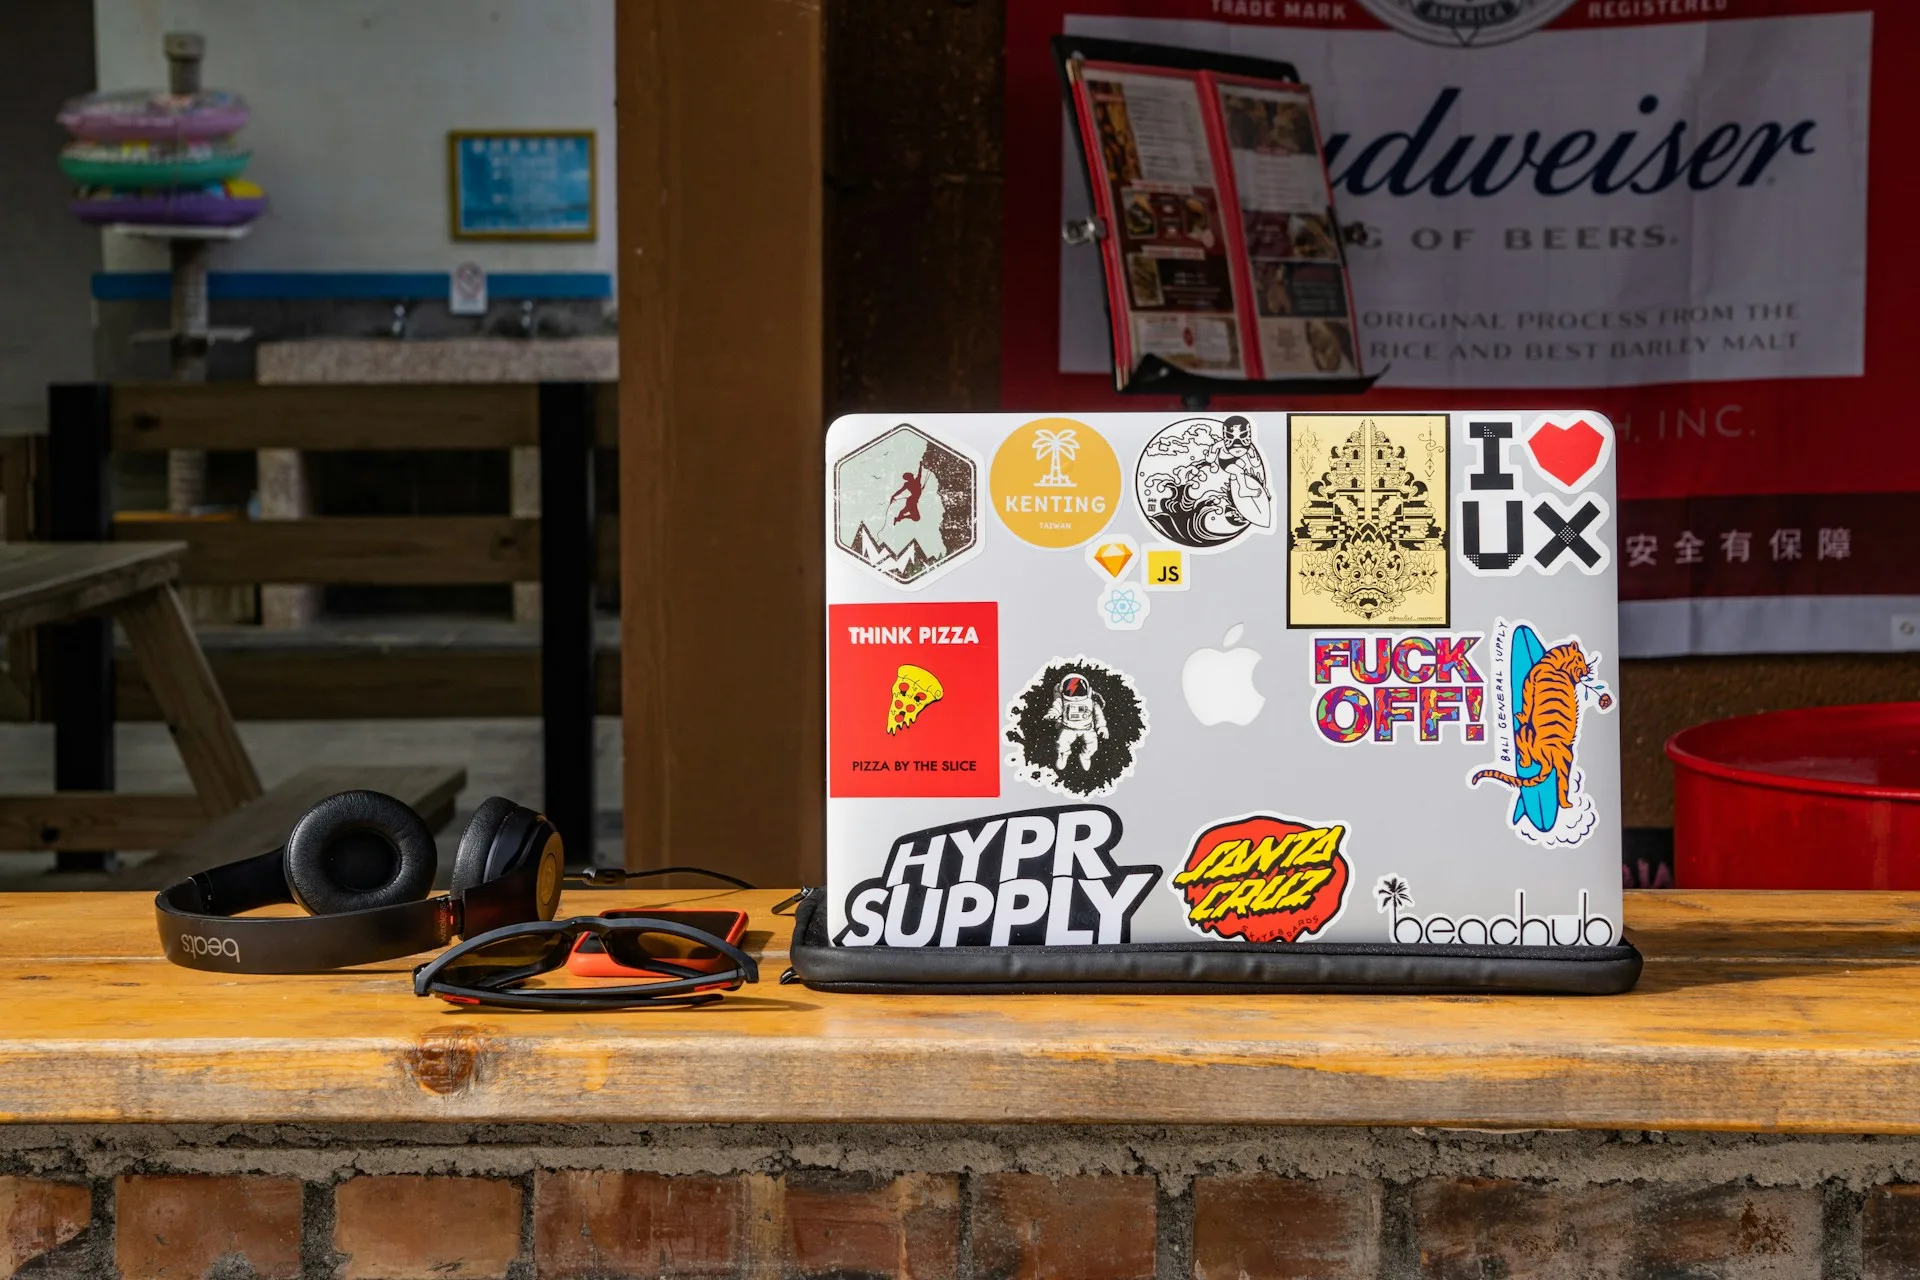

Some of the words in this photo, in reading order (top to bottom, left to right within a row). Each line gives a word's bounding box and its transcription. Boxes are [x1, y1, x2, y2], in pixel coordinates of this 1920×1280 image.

[1283, 2, 1347, 21] MARK
[1325, 87, 1817, 196] dweiser
[1411, 228, 1476, 251] OF
[1363, 310, 1506, 331] ORIGINAL
[1516, 308, 1649, 330] PROCESS
[1658, 304, 1734, 326] FROM
[1747, 301, 1800, 322] THE
[1370, 341, 1440, 361] RICE
[1448, 339, 1513, 361] AND
[1526, 338, 1599, 361] BEST
[1609, 335, 1710, 359] BARLEY
[1722, 331, 1799, 353] MALT
[1657, 403, 1757, 441] INC.
[1005, 495, 1107, 513] KENTING
[1039, 522, 1072, 530] TAIWAN
[1461, 500, 1602, 570] UX
[1625, 525, 1852, 568] 安全有保障
[1157, 565, 1179, 582] JS
[848, 626, 912, 645] THINK
[918, 626, 980, 645] PIZZA
[1496, 621, 1508, 662] SUPPLY
[1314, 636, 1485, 685] FUCK
[1316, 685, 1485, 743] OFF!
[1496, 670, 1507, 729] GENERAL
[852, 761, 891, 772] PIZZA
[894, 760, 911, 772] BY
[913, 760, 938, 772] THE
[942, 760, 977, 772] SLICE
[1500, 736, 1511, 762] BALI
[886, 809, 1112, 888] HYPR
[1173, 825, 1346, 889] SANTA
[842, 873, 1154, 948] SUPPLY
[1188, 868, 1336, 926] CRUZ
[1393, 892, 1613, 946] beachub
[181, 933, 241, 963] beats
